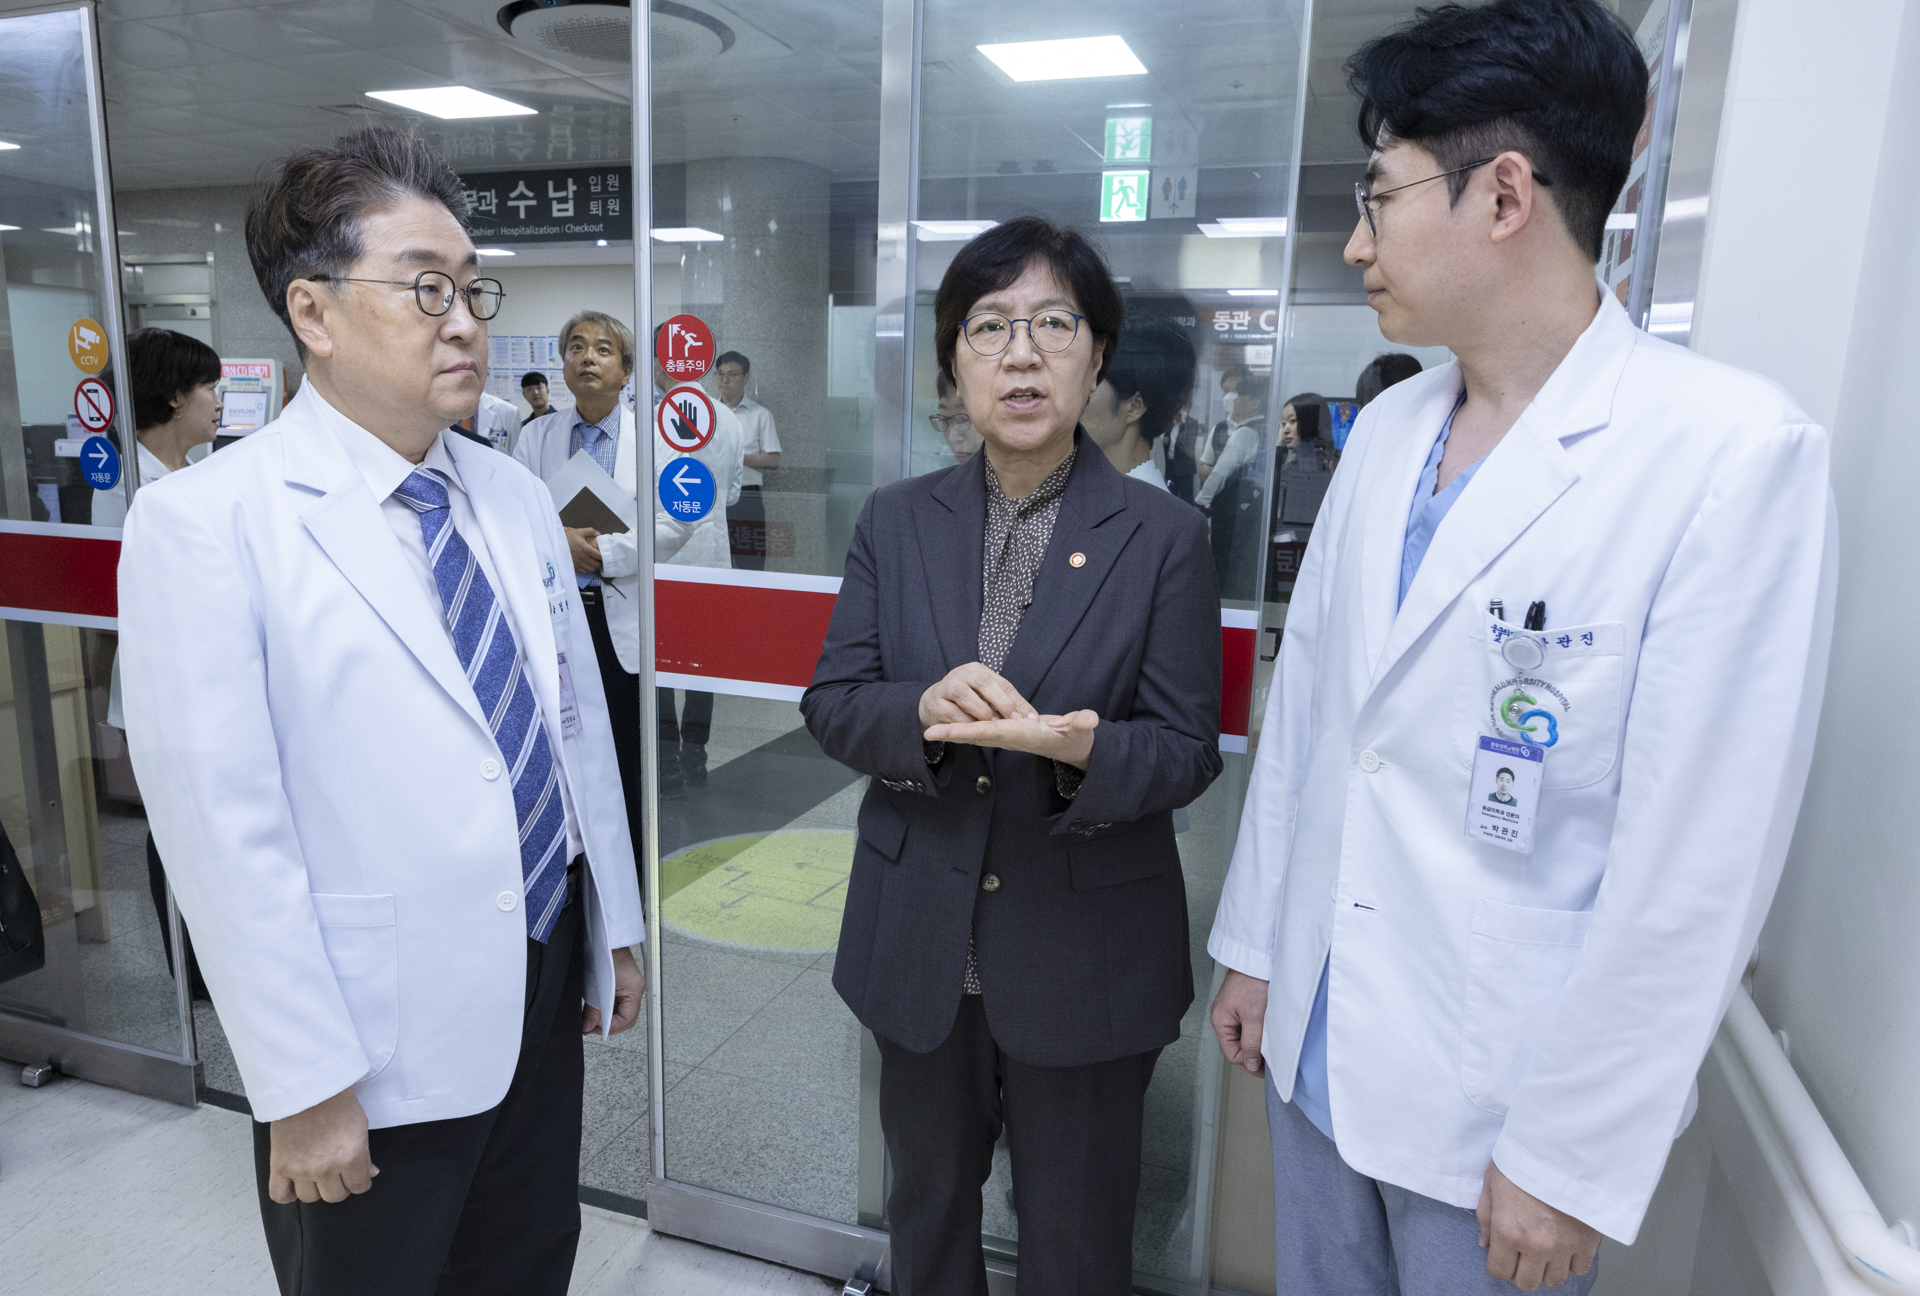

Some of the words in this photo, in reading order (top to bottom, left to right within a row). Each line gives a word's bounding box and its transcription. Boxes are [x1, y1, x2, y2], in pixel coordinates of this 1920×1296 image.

[588, 174, 619, 192] 입원
[463, 188, 498, 215] 무과
[507, 177, 577, 219] 수납
[589, 198, 620, 216] 퇴원
[500, 224, 560, 237] Hospitalization
[565, 223, 604, 233] Checkout
[1213, 310, 1251, 331] 동관
[1259, 309, 1276, 331] C
[80, 356, 99, 365] CCTV
[666, 359, 705, 373] 충돌주의
[90, 472, 112, 484] 자동문
[672, 500, 702, 514] 자동문
[1542, 631, 1593, 649] 관진
[1500, 677, 1547, 689] UNIRSITY
[1545, 683, 1572, 712] HOSPITAL
